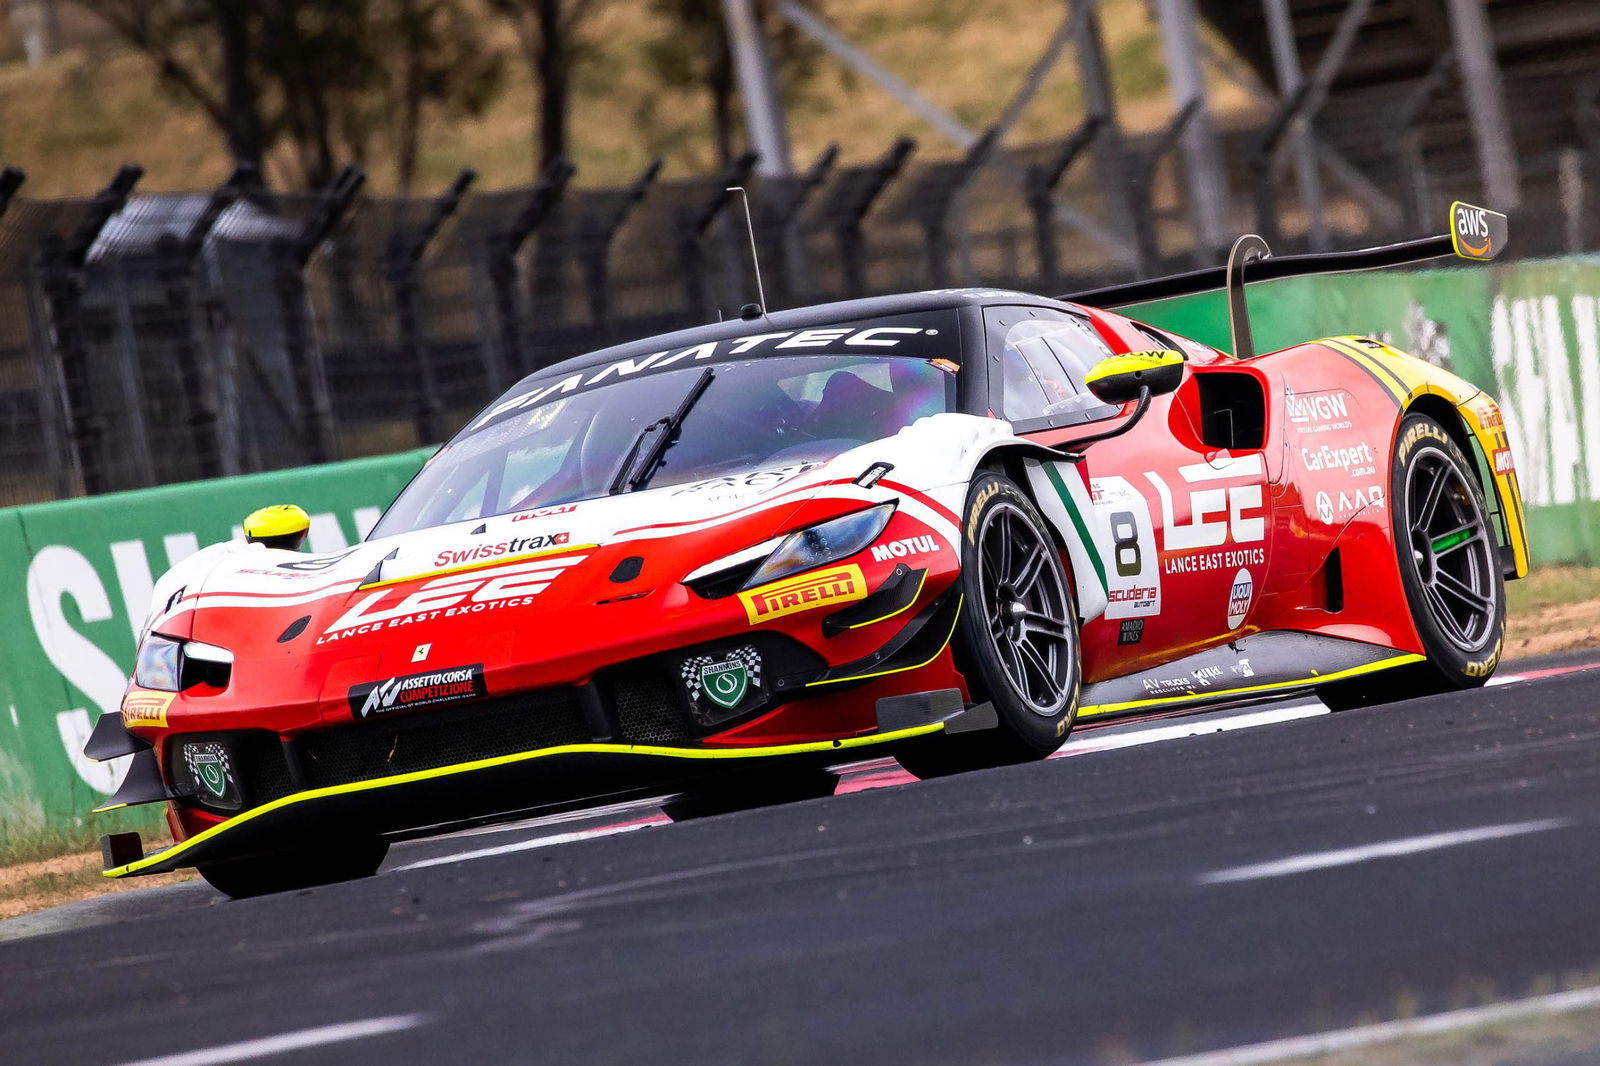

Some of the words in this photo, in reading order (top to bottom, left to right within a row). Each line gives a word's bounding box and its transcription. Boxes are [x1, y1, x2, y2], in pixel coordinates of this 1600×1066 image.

[1457, 208, 1488, 237] aws
[470, 327, 924, 432] FANATEC
[1304, 393, 1348, 420] VGW
[1301, 441, 1373, 472] CarExpert
[1398, 422, 1448, 468] PIRELLI
[967, 481, 999, 547] PIRELLI
[434, 534, 560, 567] Swisstrax
[870, 534, 940, 562] MOTUL
[1110, 511, 1142, 577] 8
[1165, 555, 1198, 574] LANCE
[1200, 552, 1223, 571] EAST
[1225, 547, 1265, 567] EXOTICS
[750, 571, 855, 616] PIRELLI
[1232, 583, 1251, 599] LIQUI
[316, 622, 382, 645] LANCE
[388, 611, 440, 628] EAST
[445, 596, 534, 617] EXOTICS
[1230, 600, 1249, 615] MOLY
[1121, 619, 1144, 632] AMADIO
[402, 674, 442, 691] ASSETTO
[442, 668, 473, 684] CORSA
[702, 659, 742, 675] SHANNONS
[400, 680, 474, 704] COMPETIZIONE
[1143, 678, 1160, 690] AV
